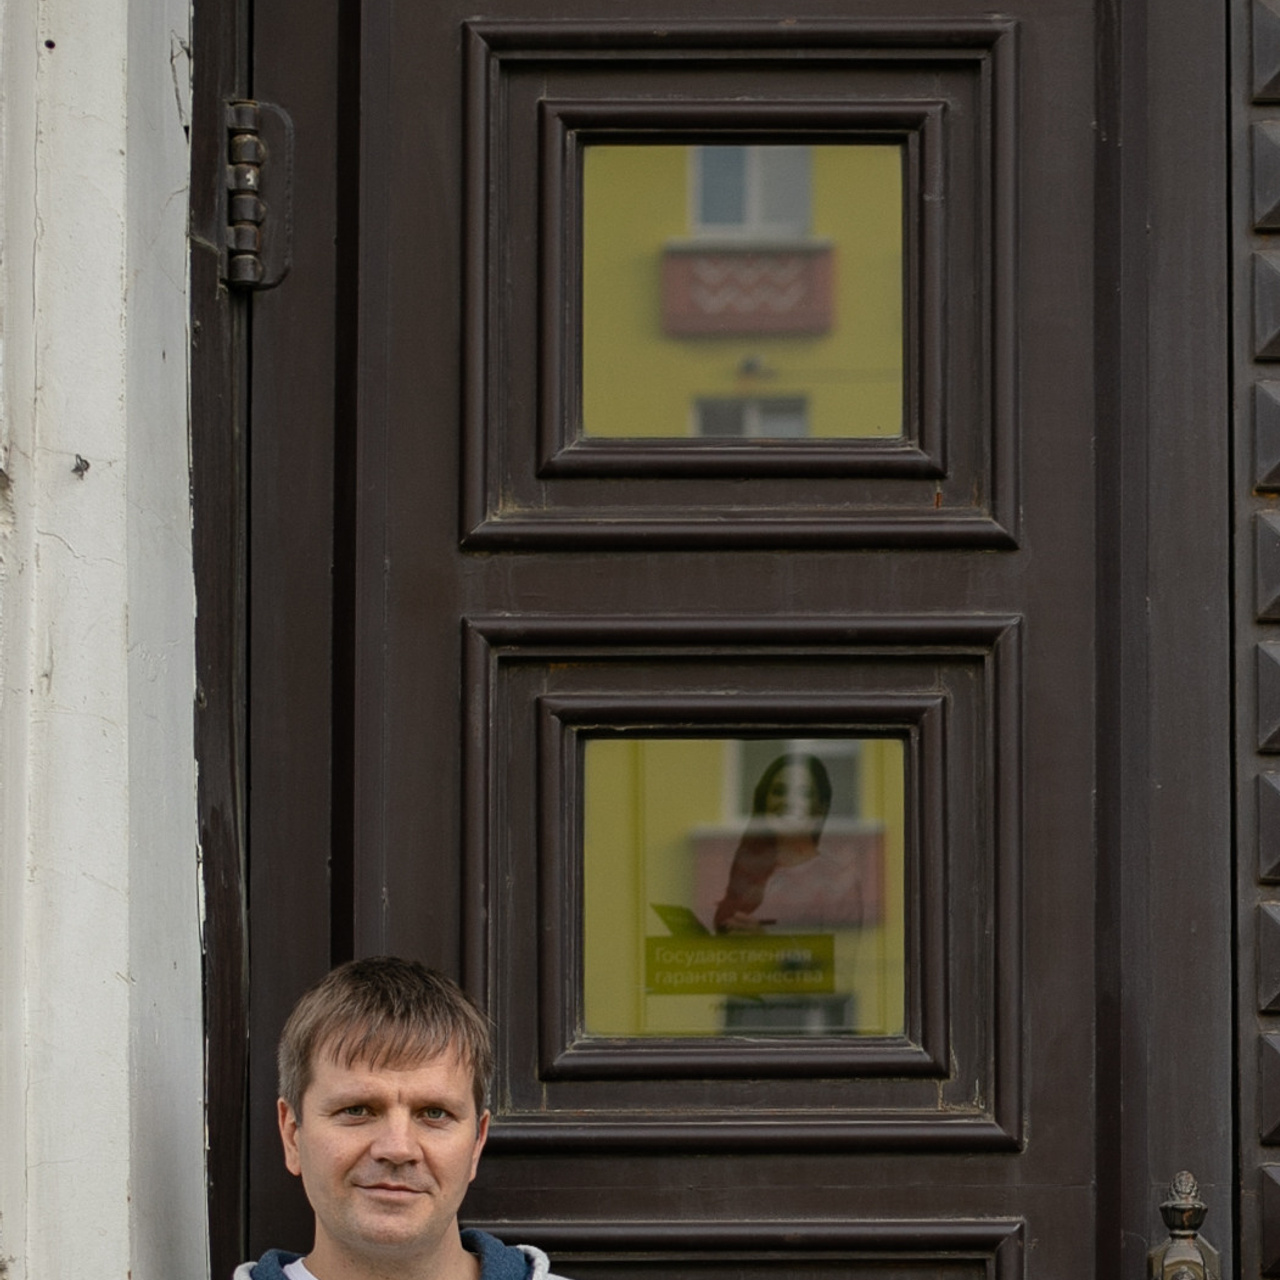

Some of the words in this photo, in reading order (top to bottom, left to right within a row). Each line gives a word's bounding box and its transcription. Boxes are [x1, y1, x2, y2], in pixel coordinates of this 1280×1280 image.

[655, 946, 812, 968] Государственная
[655, 970, 738, 986] гарантия
[742, 970, 824, 985] качества
